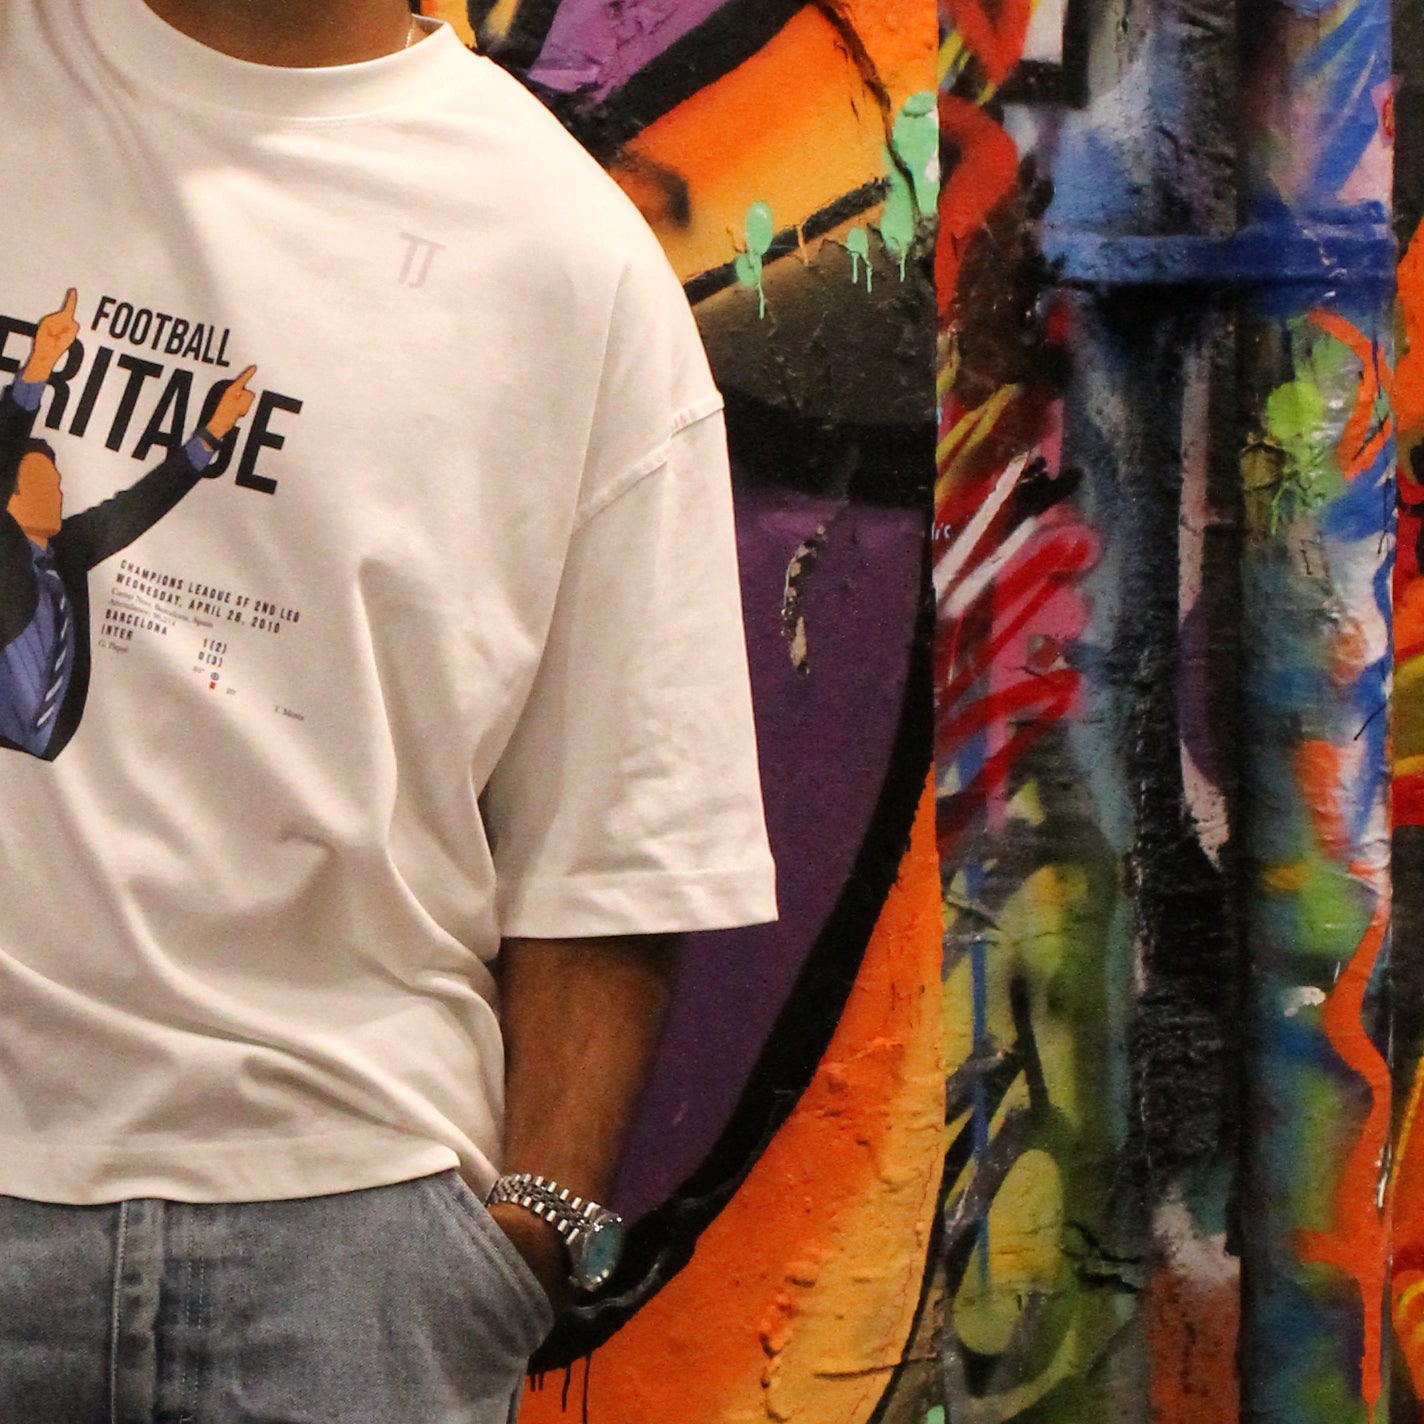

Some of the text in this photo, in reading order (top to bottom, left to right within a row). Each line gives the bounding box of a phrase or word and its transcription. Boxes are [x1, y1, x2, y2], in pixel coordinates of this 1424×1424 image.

[91, 296, 230, 367] FOOTBALL
[120, 560, 183, 589] CHAMPIONS
[188, 582, 231, 604] LEAGUE
[236, 595, 251, 608] SF
[254, 600, 276, 616] 2ND
[101, 624, 133, 641] INTER
[105, 608, 168, 636] BARCELONA
[188, 599, 222, 617] APRIL
[250, 617, 280, 633] 2010
